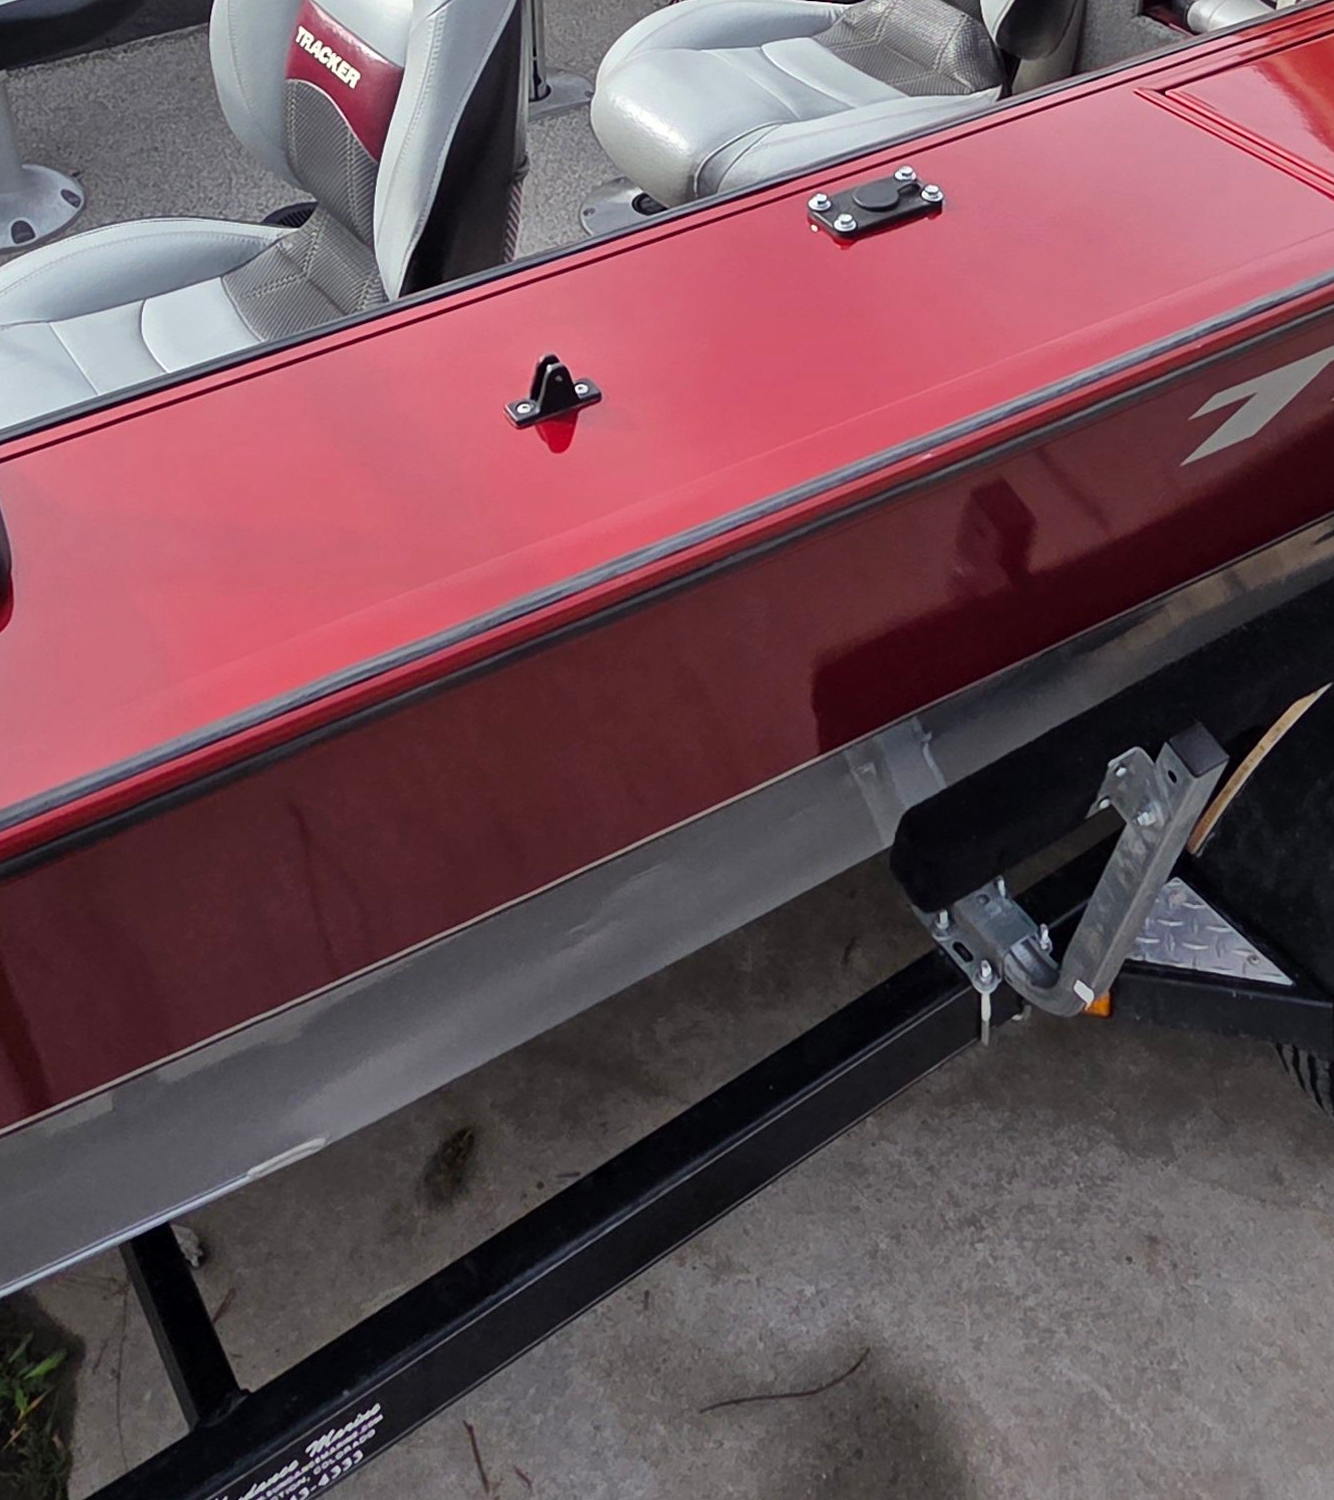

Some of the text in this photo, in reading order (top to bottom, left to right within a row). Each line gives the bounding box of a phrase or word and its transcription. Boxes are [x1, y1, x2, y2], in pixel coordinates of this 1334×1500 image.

[295, 25, 362, 90] TRACKER
[305, 1402, 381, 1458] Marine
[313, 1429, 376, 1476] COLORADO
